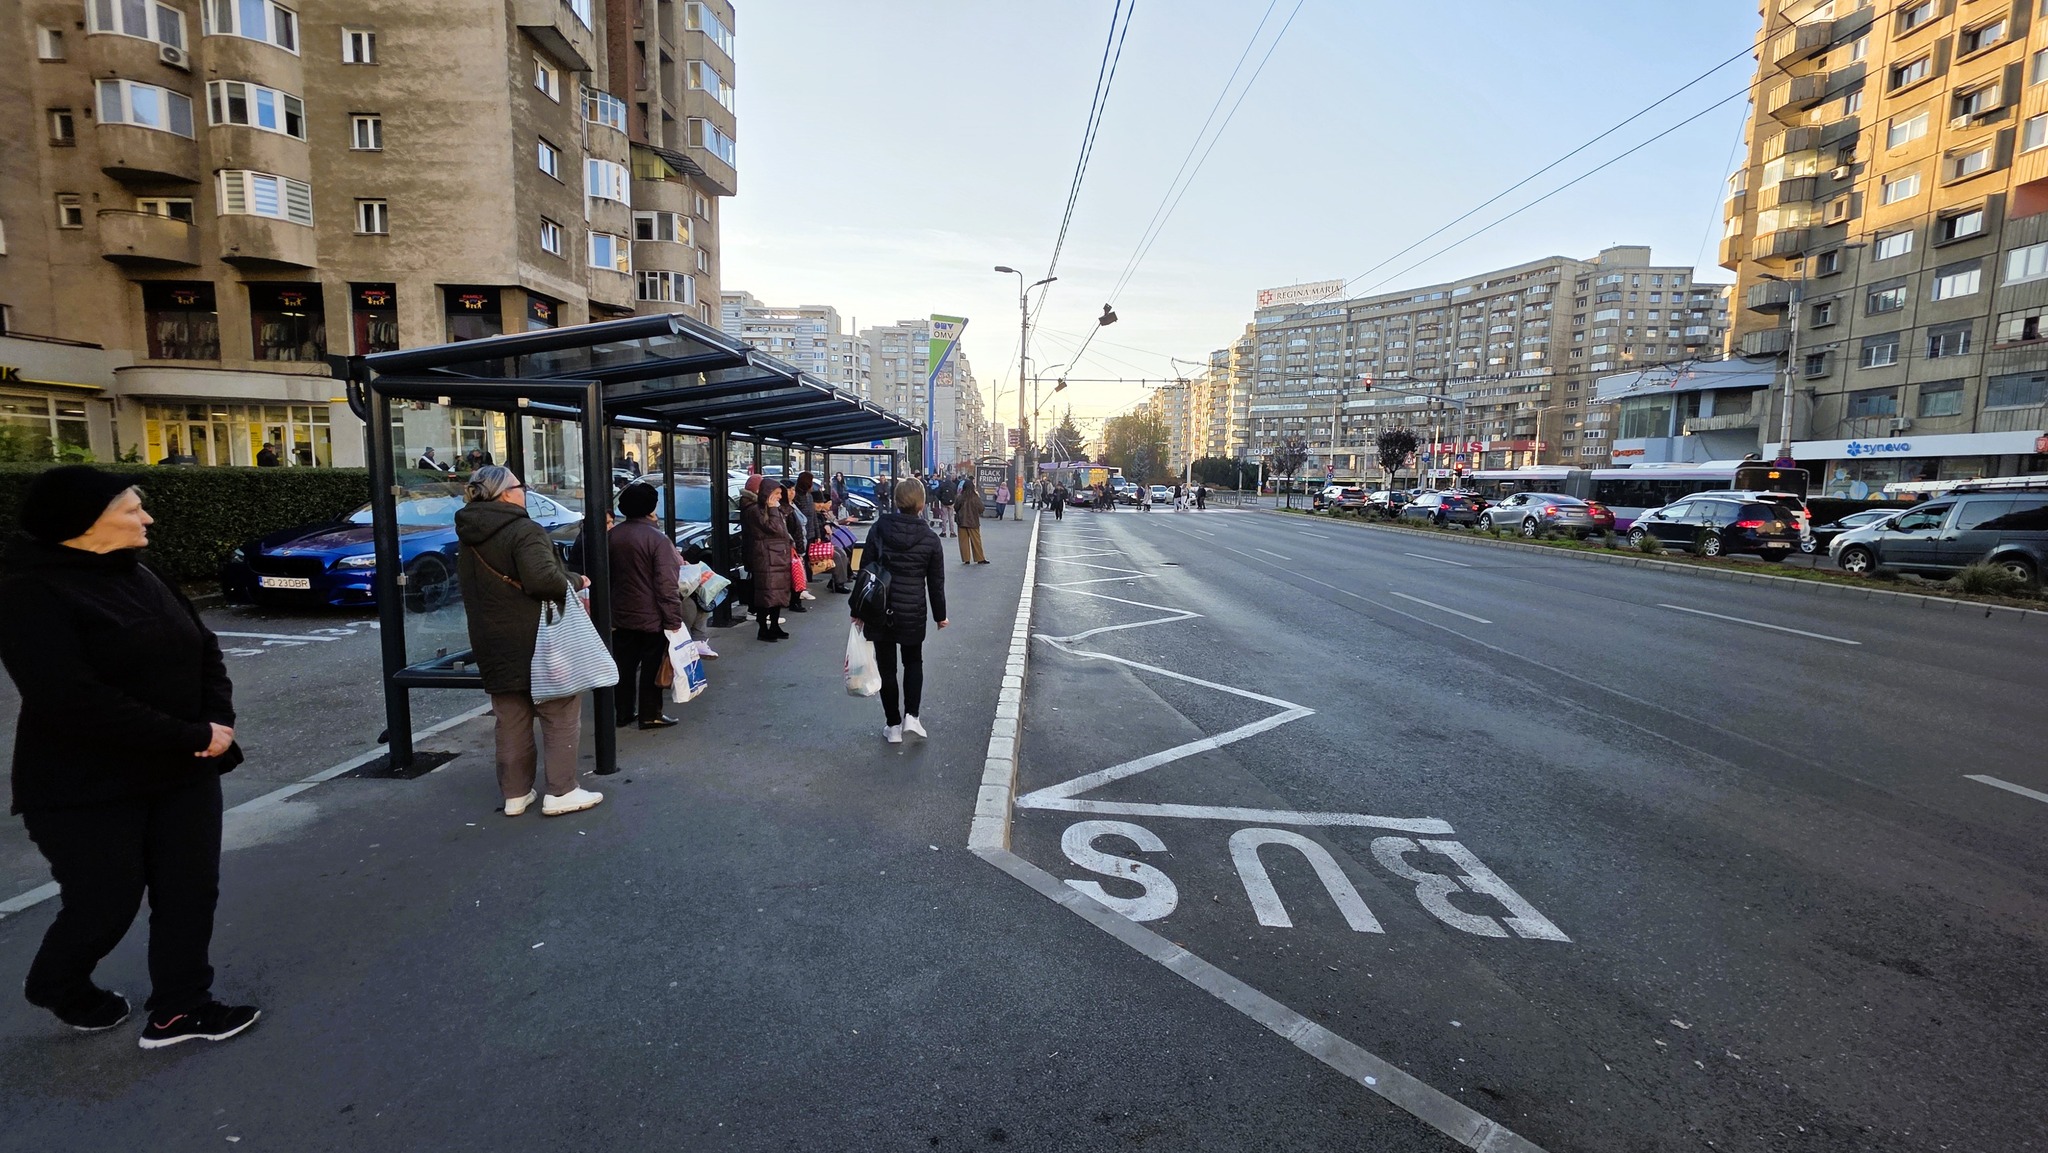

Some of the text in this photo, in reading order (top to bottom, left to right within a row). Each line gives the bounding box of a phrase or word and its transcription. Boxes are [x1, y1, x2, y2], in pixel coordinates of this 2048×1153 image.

[1276, 289, 1308, 299] REGINA
[1312, 285, 1340, 294] MARIA
[934, 331, 953, 339] OMV
[0, 366, 20, 380] K
[1863, 443, 1911, 455] synevo
[979, 475, 1001, 483] FRIDAY
[980, 469, 1001, 477] BLACK
[1061, 820, 1573, 943] BUS
